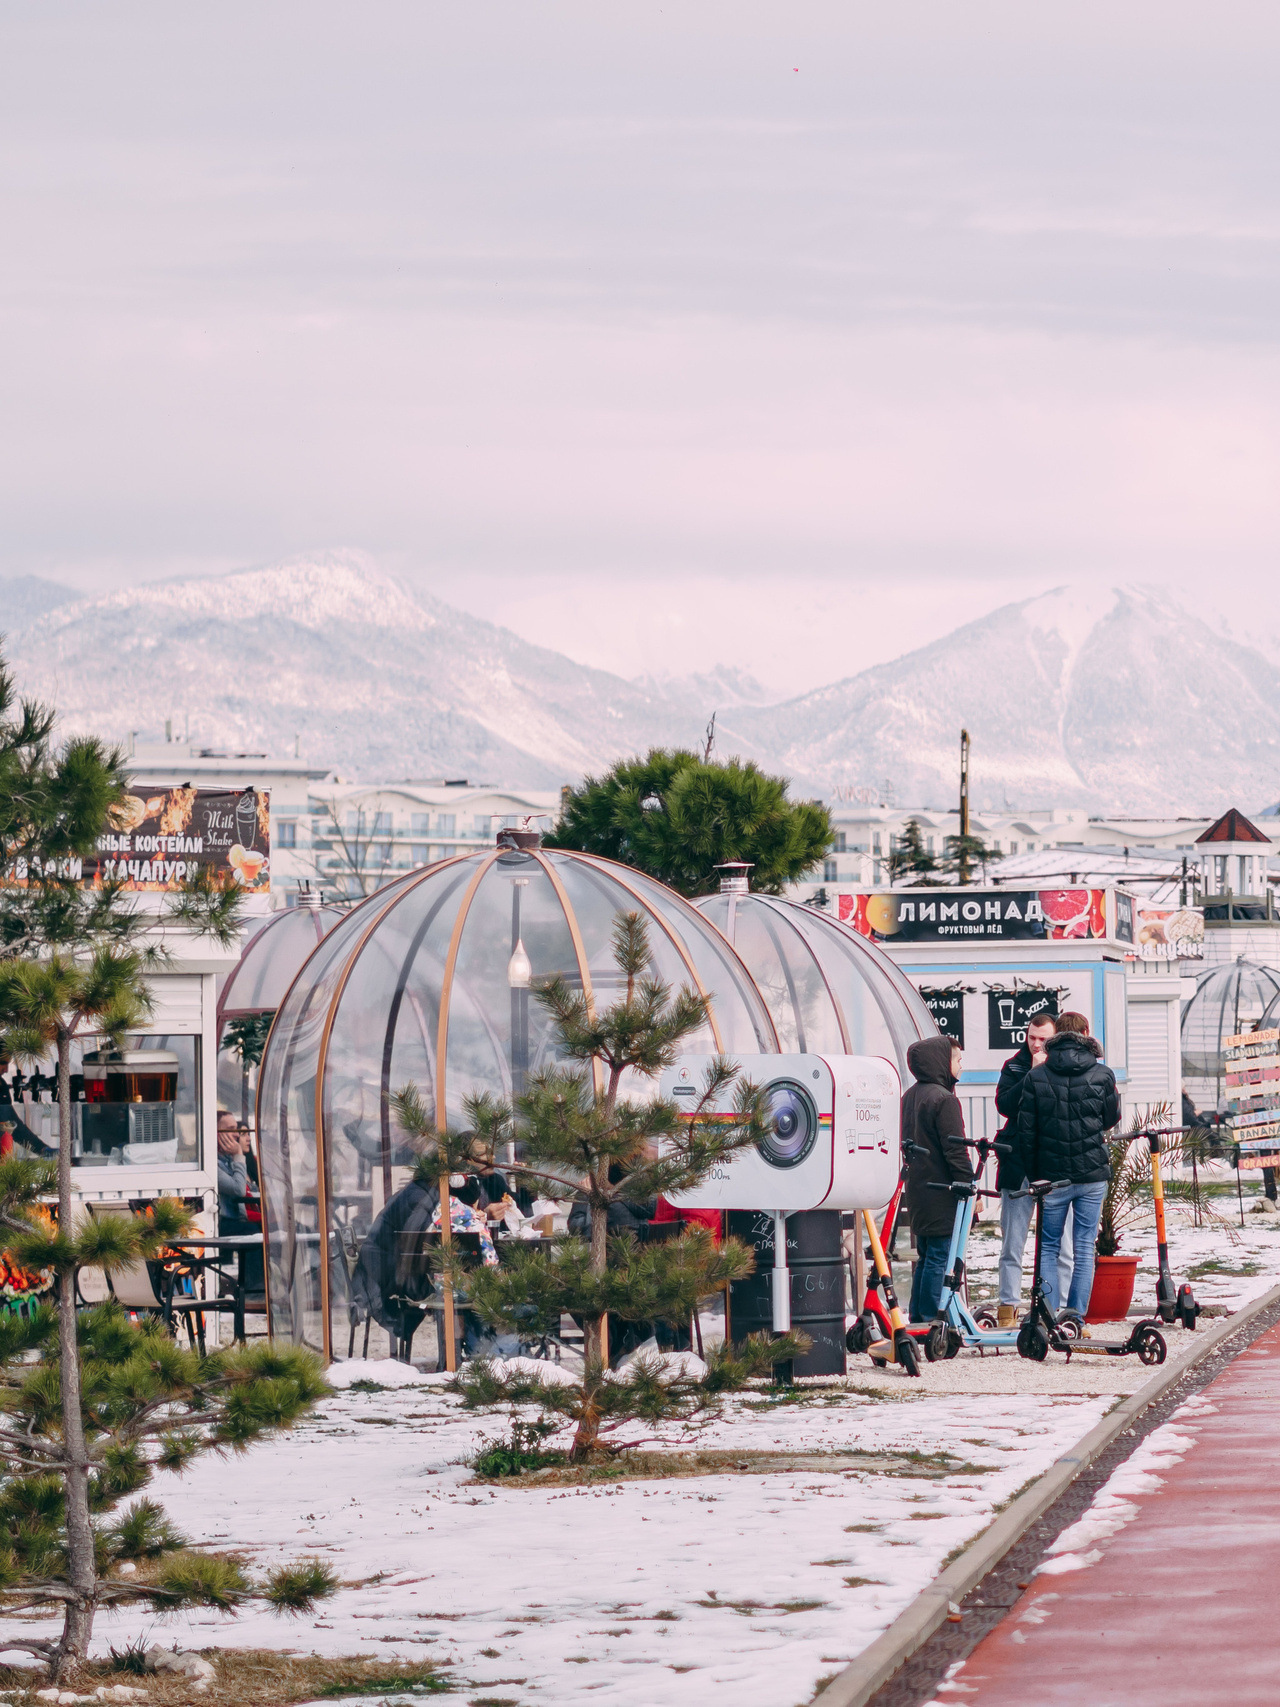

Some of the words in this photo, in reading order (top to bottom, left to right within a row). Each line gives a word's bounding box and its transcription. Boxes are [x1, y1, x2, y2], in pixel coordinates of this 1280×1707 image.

[203, 810, 234, 829] Milk
[135, 832, 203, 853] КОКТЕЙЛИ
[203, 829, 233, 846] Shake
[103, 859, 199, 882] ХАЧАПУРИ
[898, 900, 1044, 922] ЛИМОНАД
[938, 923, 985, 935] ФРУКТОВЫЙ
[986, 923, 1003, 934] ЛЁД
[939, 998, 959, 1009] ЧАЙ
[1227, 1030, 1275, 1046] LEMONADE
[1238, 1069, 1265, 1083] KIWI
[1239, 1096, 1279, 1110] LEMON
[1240, 1111, 1274, 1124] APPLE
